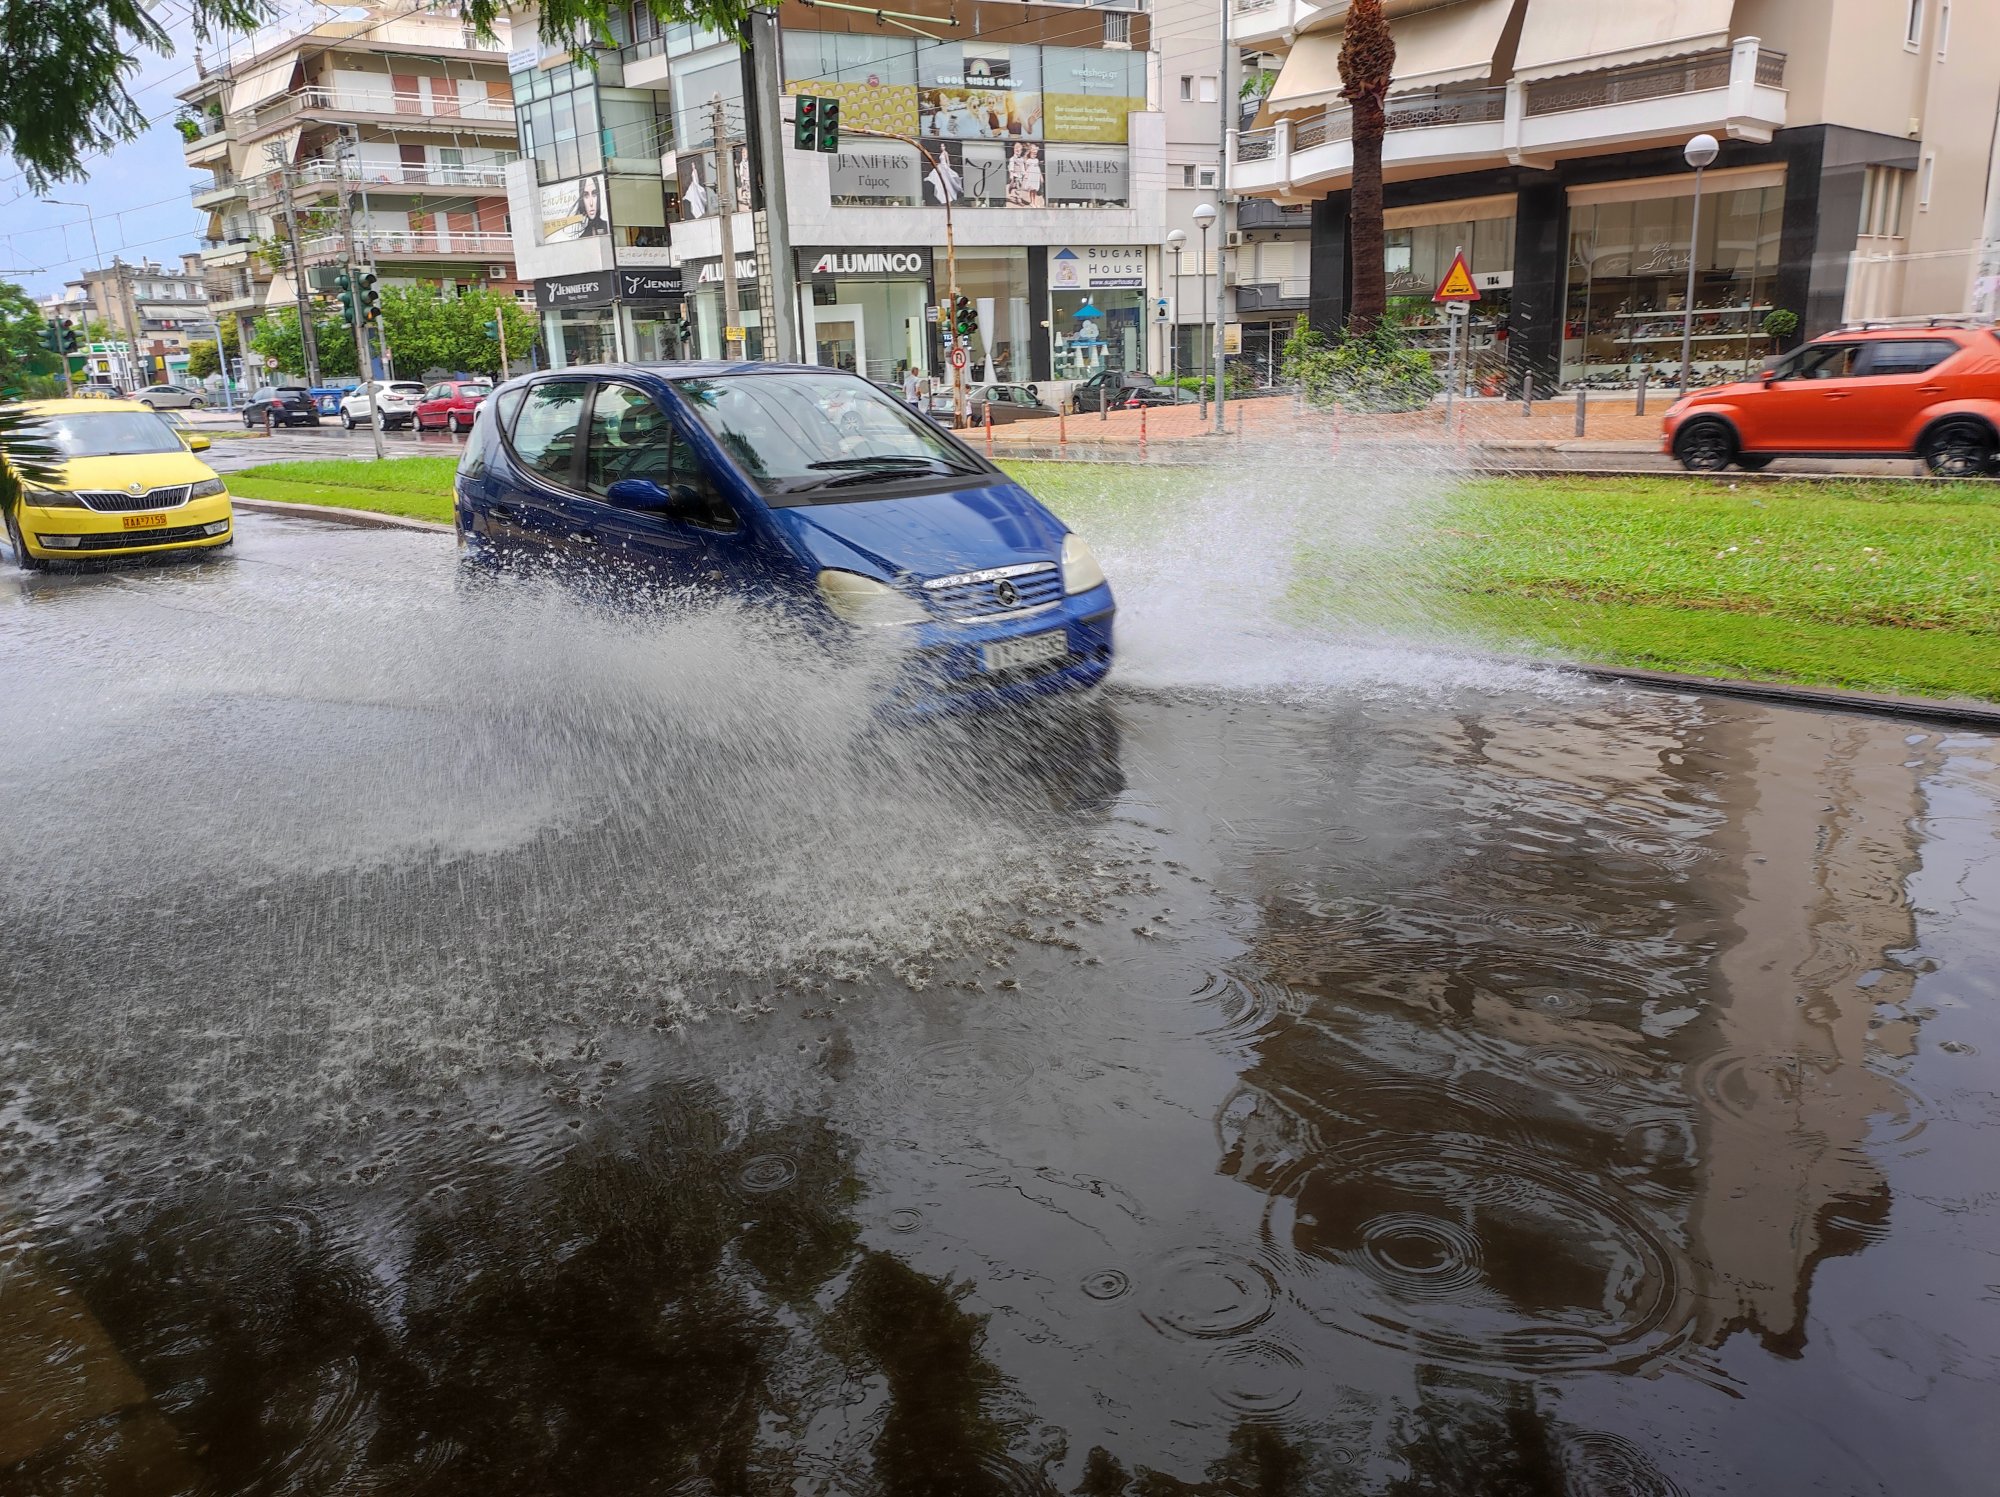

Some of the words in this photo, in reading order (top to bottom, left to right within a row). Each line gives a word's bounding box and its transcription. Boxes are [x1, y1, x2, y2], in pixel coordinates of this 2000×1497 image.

[1072, 68, 1118, 79] wedshop.gr
[966, 77, 996, 86] VIBES
[997, 79, 1023, 87] ONLY
[837, 153, 909, 173] JENNIFER'S
[1056, 159, 1119, 176] JENNIFER'S
[858, 174, 890, 188] Γάμος
[1071, 179, 1107, 192] Βάπτιση
[1088, 248, 1142, 258] SUGAR
[812, 253, 922, 273] ALUMINCO
[1089, 264, 1143, 274] HOUSE
[698, 259, 757, 283] ALUINC
[643, 280, 683, 289] JENNIF
[1090, 279, 1141, 288] www.sugarhouse.gr
[1486, 276, 1500, 286] 184
[557, 282, 599, 296] JENNIFER'S
